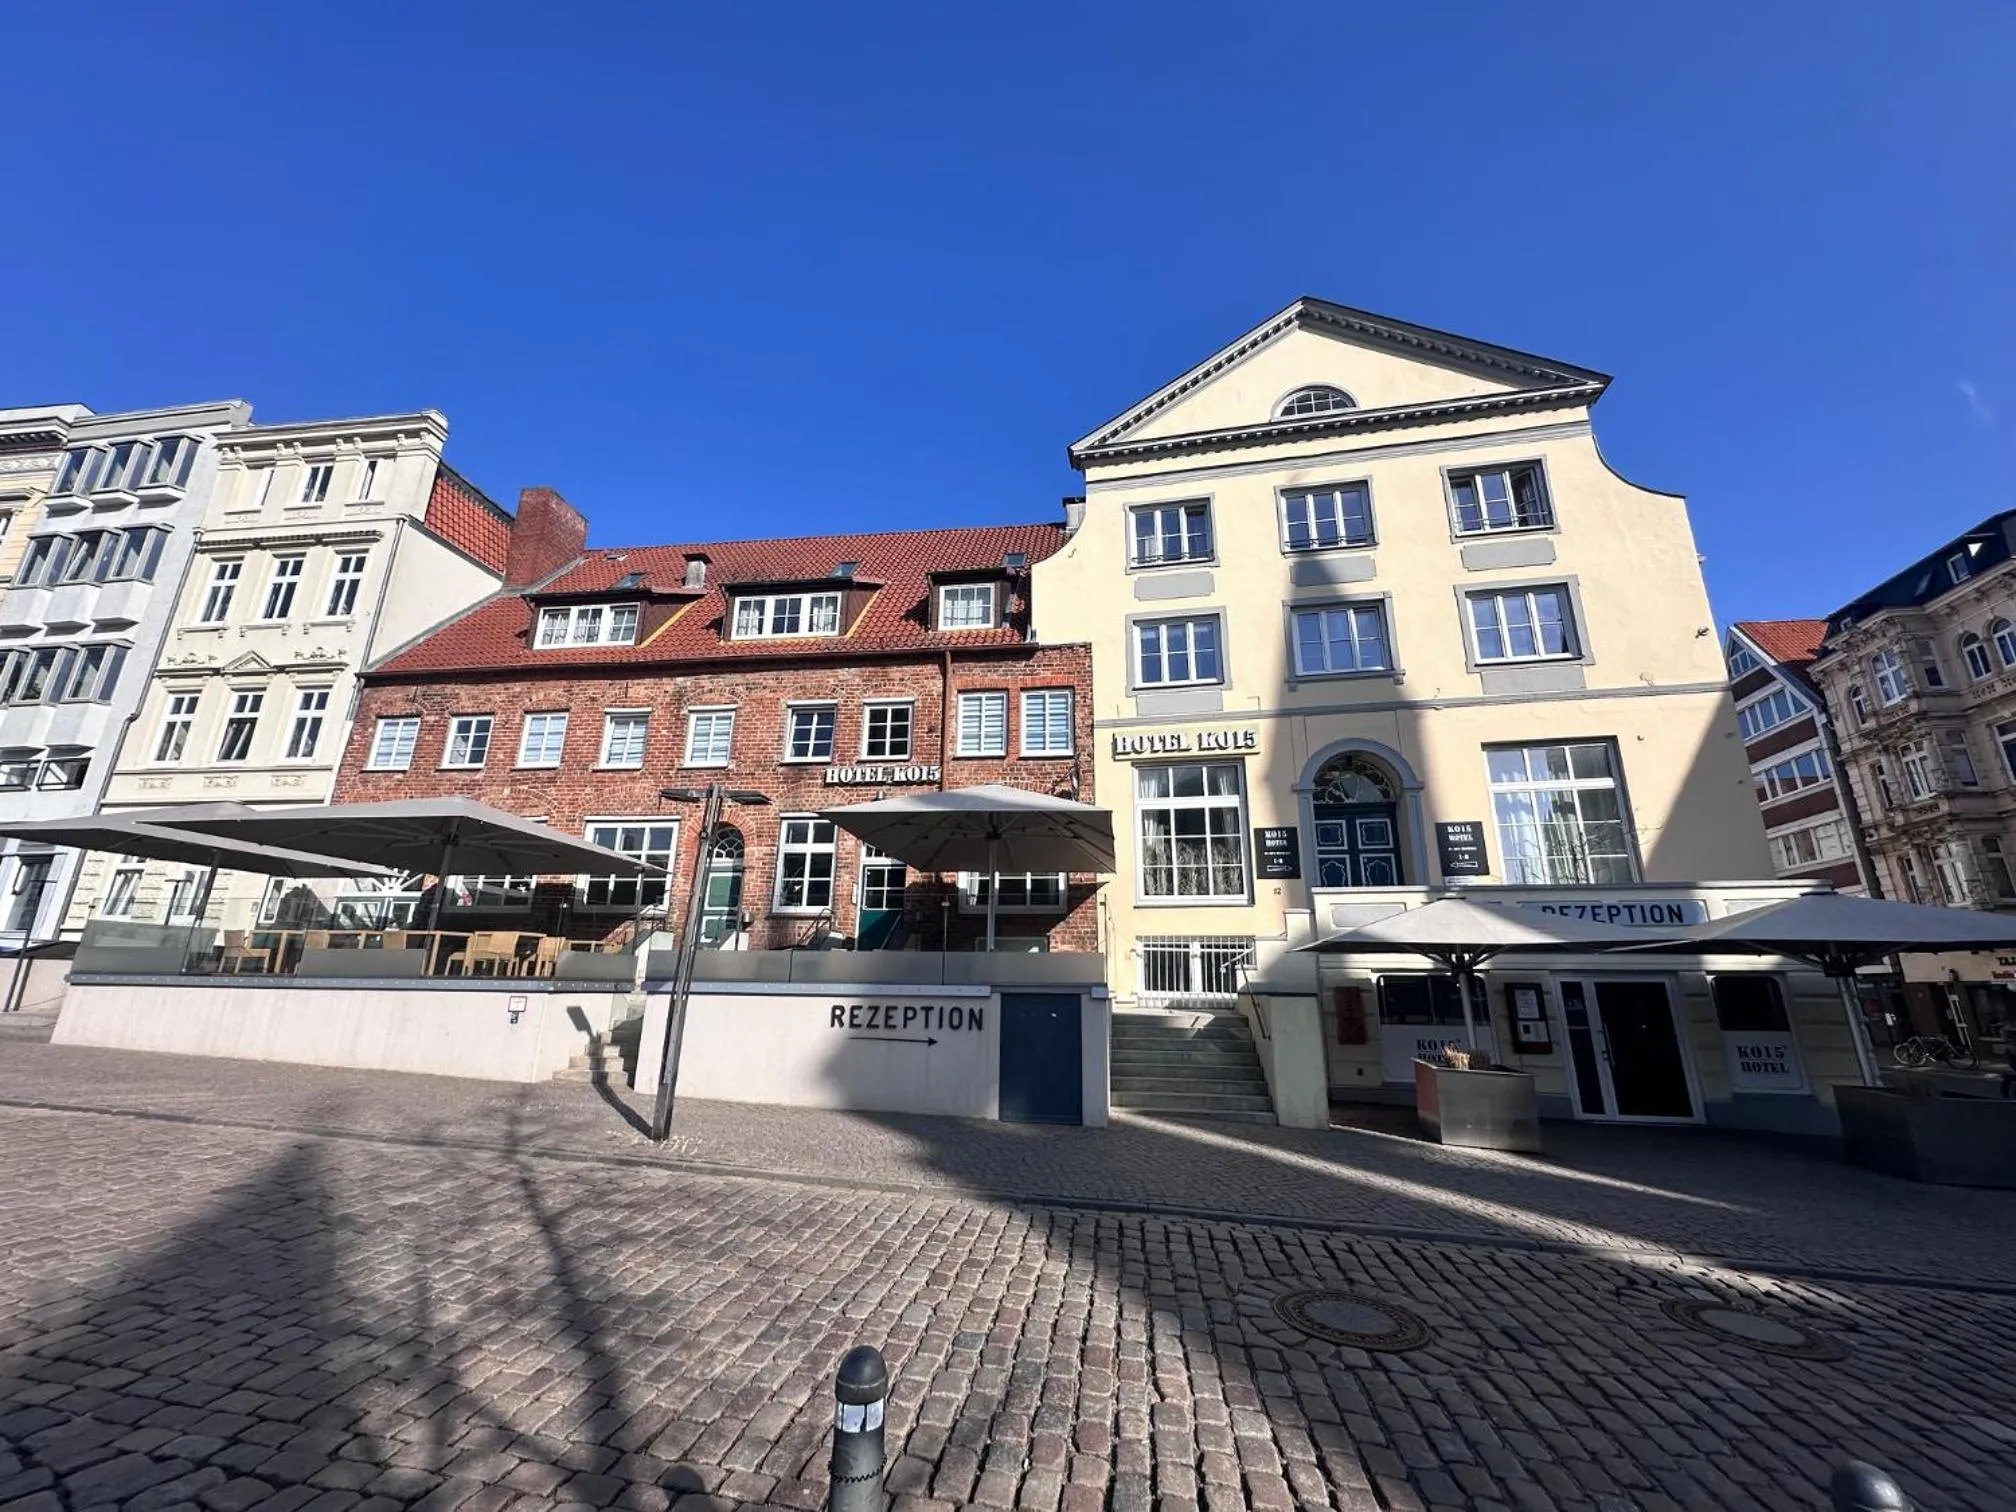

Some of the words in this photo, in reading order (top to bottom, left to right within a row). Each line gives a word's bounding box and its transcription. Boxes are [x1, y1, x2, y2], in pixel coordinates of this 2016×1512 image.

[1114, 733, 1192, 754] HOTEL
[1198, 730, 1257, 751] KO15
[825, 767, 887, 783] HOTEL
[893, 765, 941, 782] KO15
[830, 1004, 985, 1031] REZEPTION
[1737, 1045, 1786, 1059] KO15
[1741, 1061, 1790, 1073] HOTEL
